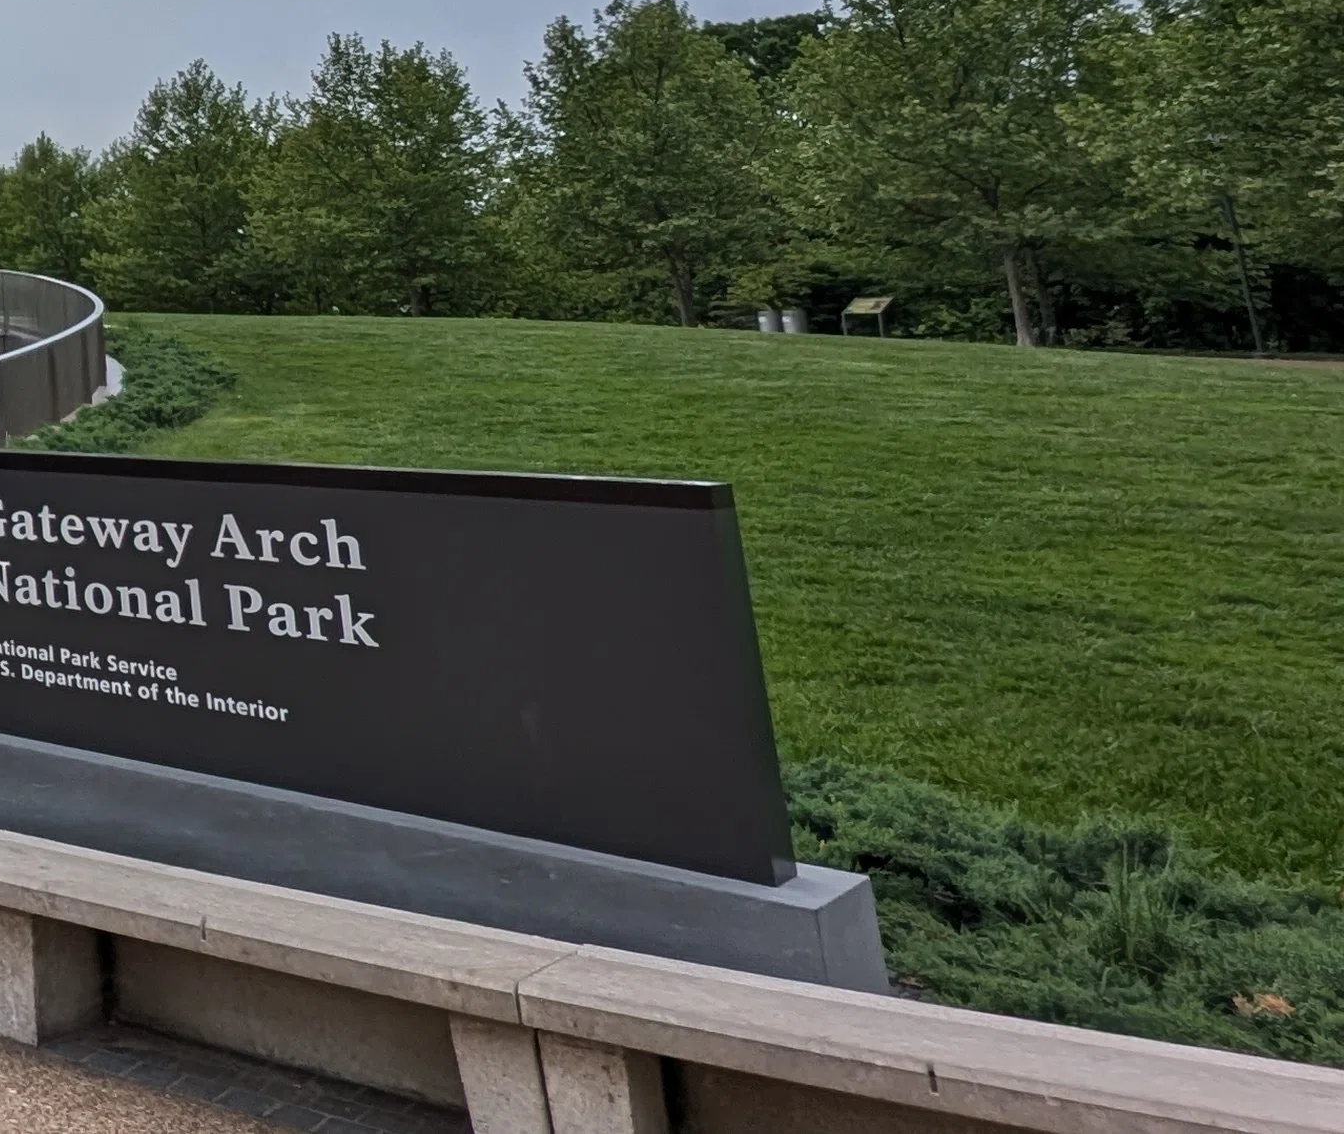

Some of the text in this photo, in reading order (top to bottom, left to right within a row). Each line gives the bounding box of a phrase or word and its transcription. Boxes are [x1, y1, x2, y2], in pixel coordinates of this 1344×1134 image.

[210, 514, 367, 570] Arch
[223, 583, 379, 647] Park
[21, 663, 132, 697] Department
[138, 683, 159, 701] of
[165, 686, 199, 708] the
[206, 692, 289, 722] Interior
[60, 647, 101, 670] Park
[106, 655, 178, 681] Service
